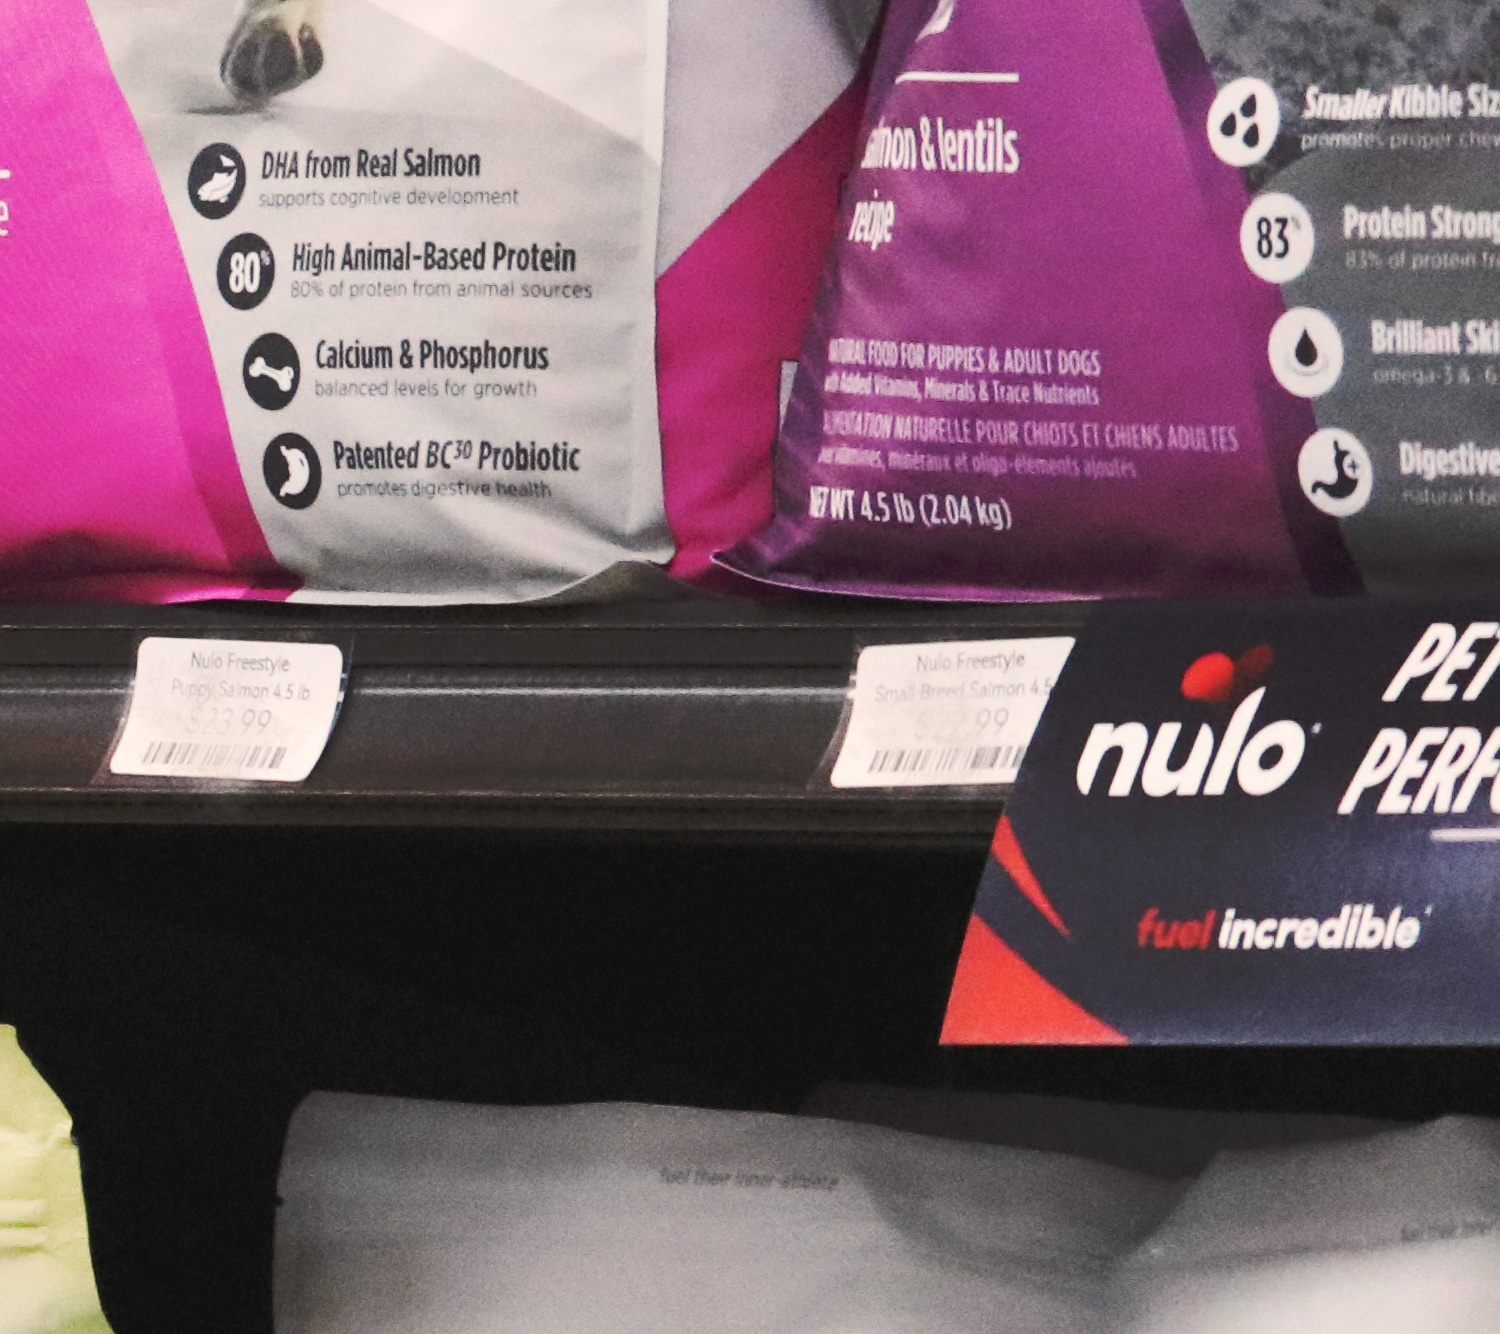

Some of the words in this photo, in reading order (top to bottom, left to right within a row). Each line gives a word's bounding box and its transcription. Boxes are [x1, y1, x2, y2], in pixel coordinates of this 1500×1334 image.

[1301, 85, 1389, 120] Smaller
[1389, 83, 1463, 118] Kibble
[937, 117, 1021, 173] lentils
[262, 151, 299, 179] DHA
[305, 150, 350, 178] from
[356, 149, 398, 177] Real
[404, 148, 481, 178] Salmon
[1343, 204, 1427, 239] Protein
[293, 241, 335, 276] High
[341, 241, 487, 273] Animal-Based
[493, 242, 577, 273] Protein
[1371, 319, 1461, 354] Brilliant
[316, 339, 393, 370] Calcium
[399, 341, 413, 370] &
[420, 341, 549, 375] Phosphorus
[901, 342, 924, 367] FOR
[928, 345, 985, 371] PUPPIES
[988, 348, 999, 373] &
[1004, 348, 1054, 375] ADULT
[1058, 349, 1100, 377] DOGS
[333, 440, 419, 471] Patented
[479, 440, 581, 472] Probiotic
[1399, 440, 1500, 482] Digestive
[831, 488, 855, 519] WT
[860, 489, 888, 522] 4.5
[894, 492, 915, 523] lb
[920, 494, 972, 527] (2.04
[975, 497, 1012, 531] kg)
[191, 652, 224, 671] Nulo
[227, 653, 290, 674] Freestyle
[917, 655, 951, 672] Nulo
[956, 651, 1026, 673] Freestyle
[172, 678, 213, 699] Puppy
[220, 681, 269, 699] Salmon
[273, 683, 295, 700] 4.5
[298, 683, 311, 702] lb
[875, 684, 916, 703] Small
[920, 683, 965, 701] Breed
[1076, 686, 1306, 797] nulo
[1136, 907, 1216, 949] fuel
[1218, 905, 1421, 950] incredible
